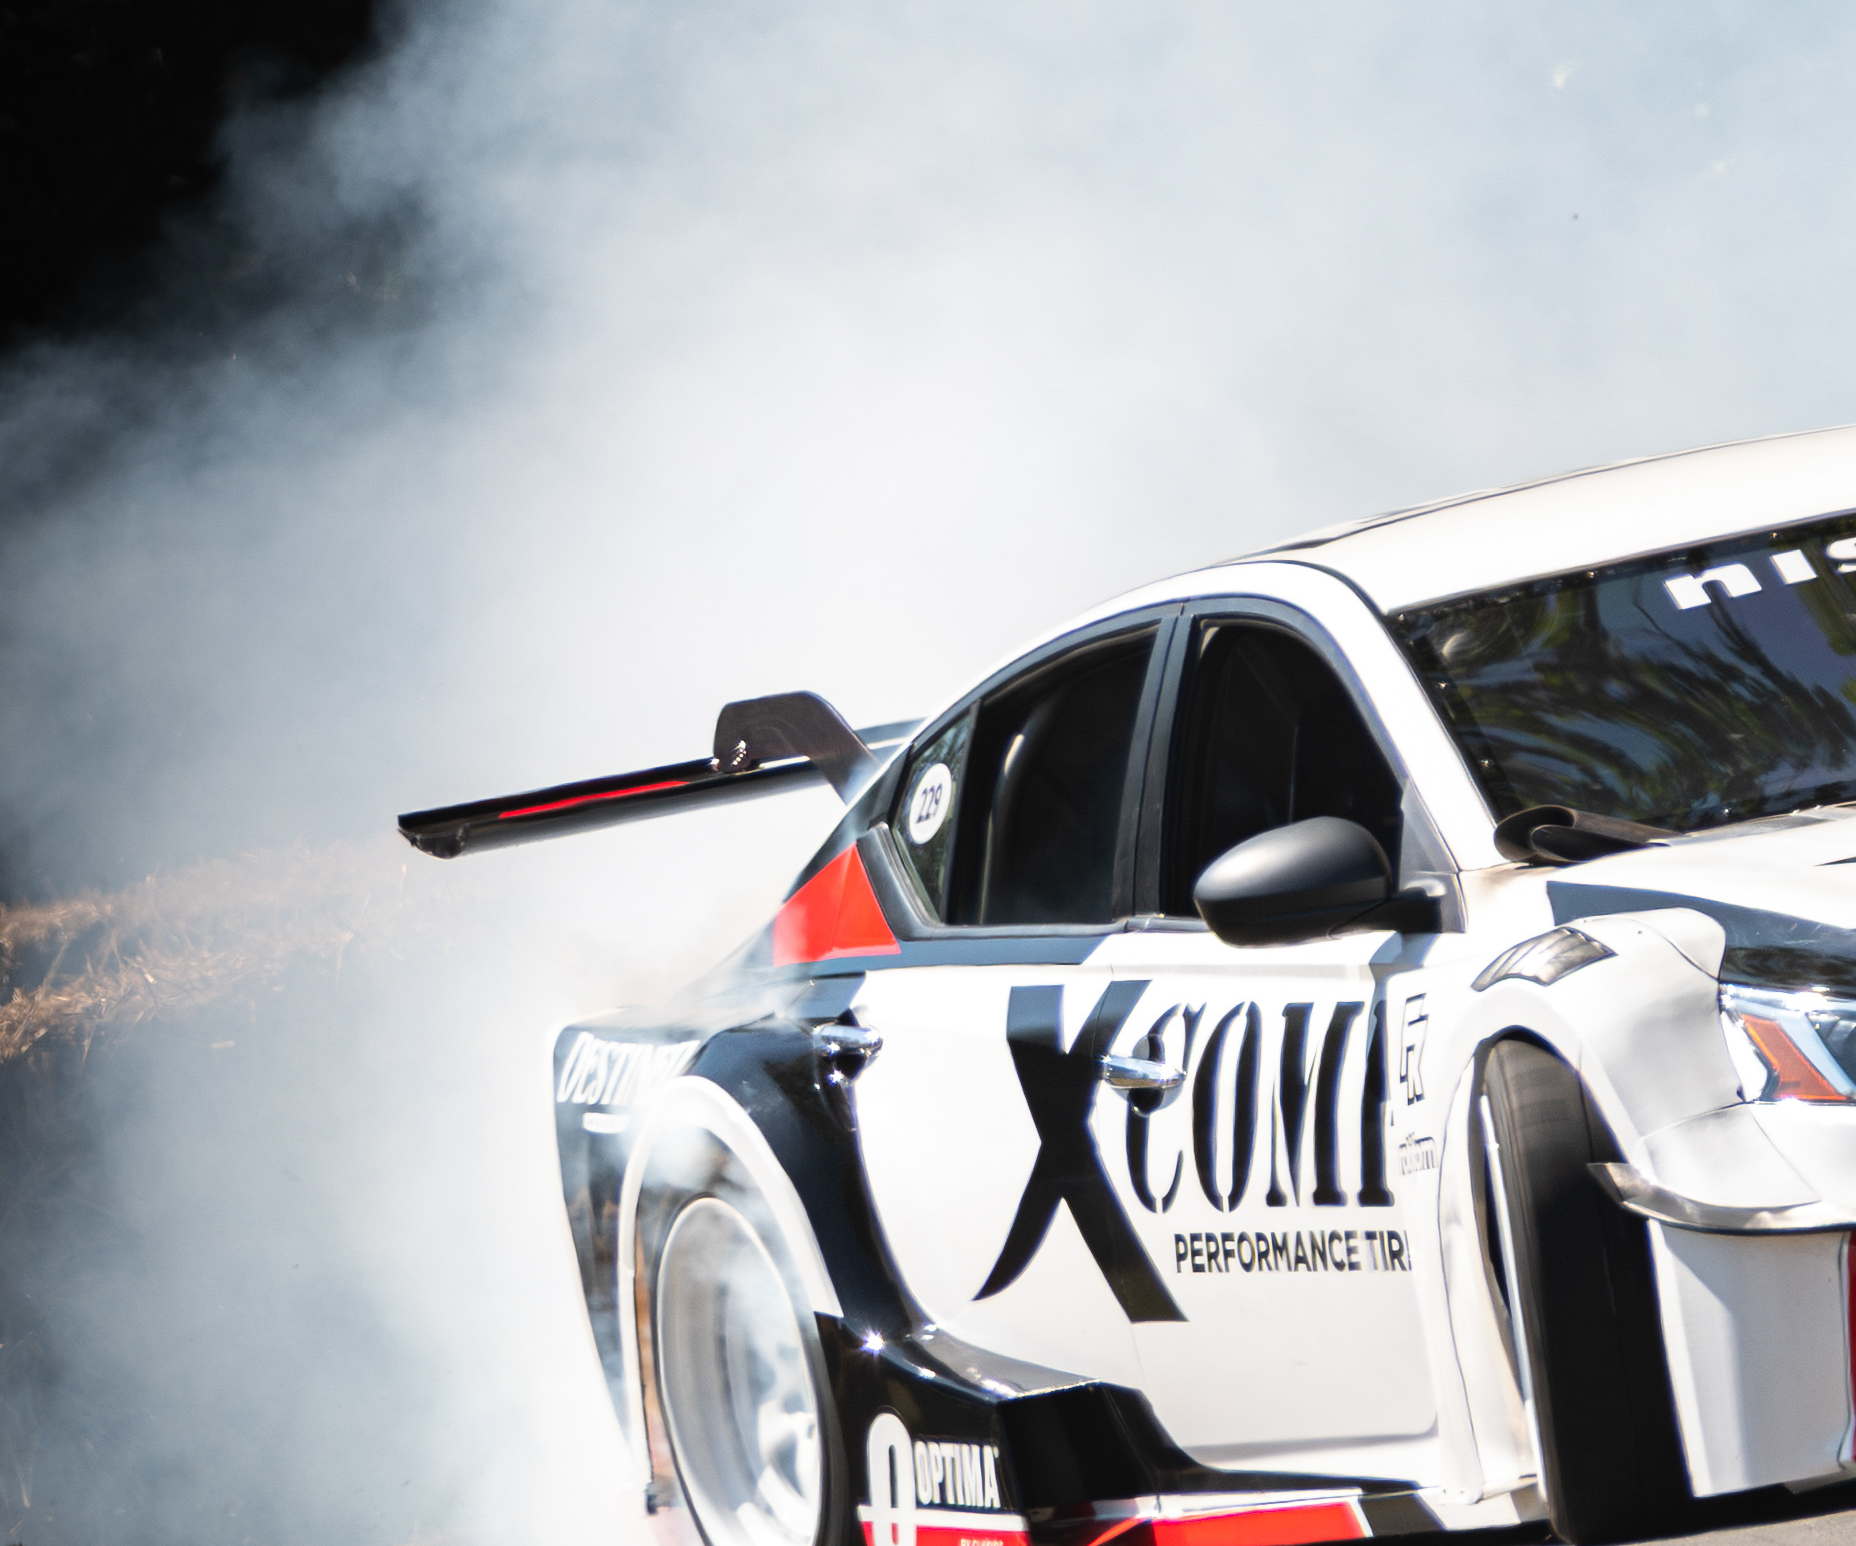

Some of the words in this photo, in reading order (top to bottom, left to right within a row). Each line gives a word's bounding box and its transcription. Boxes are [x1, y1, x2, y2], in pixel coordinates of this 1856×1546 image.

[915, 783, 943, 824] 229
[1174, 1230, 1362, 1274] PERFORMANCE
[1364, 1230, 1413, 1272] TIR
[914, 1440, 1001, 1509] OPTIMA
